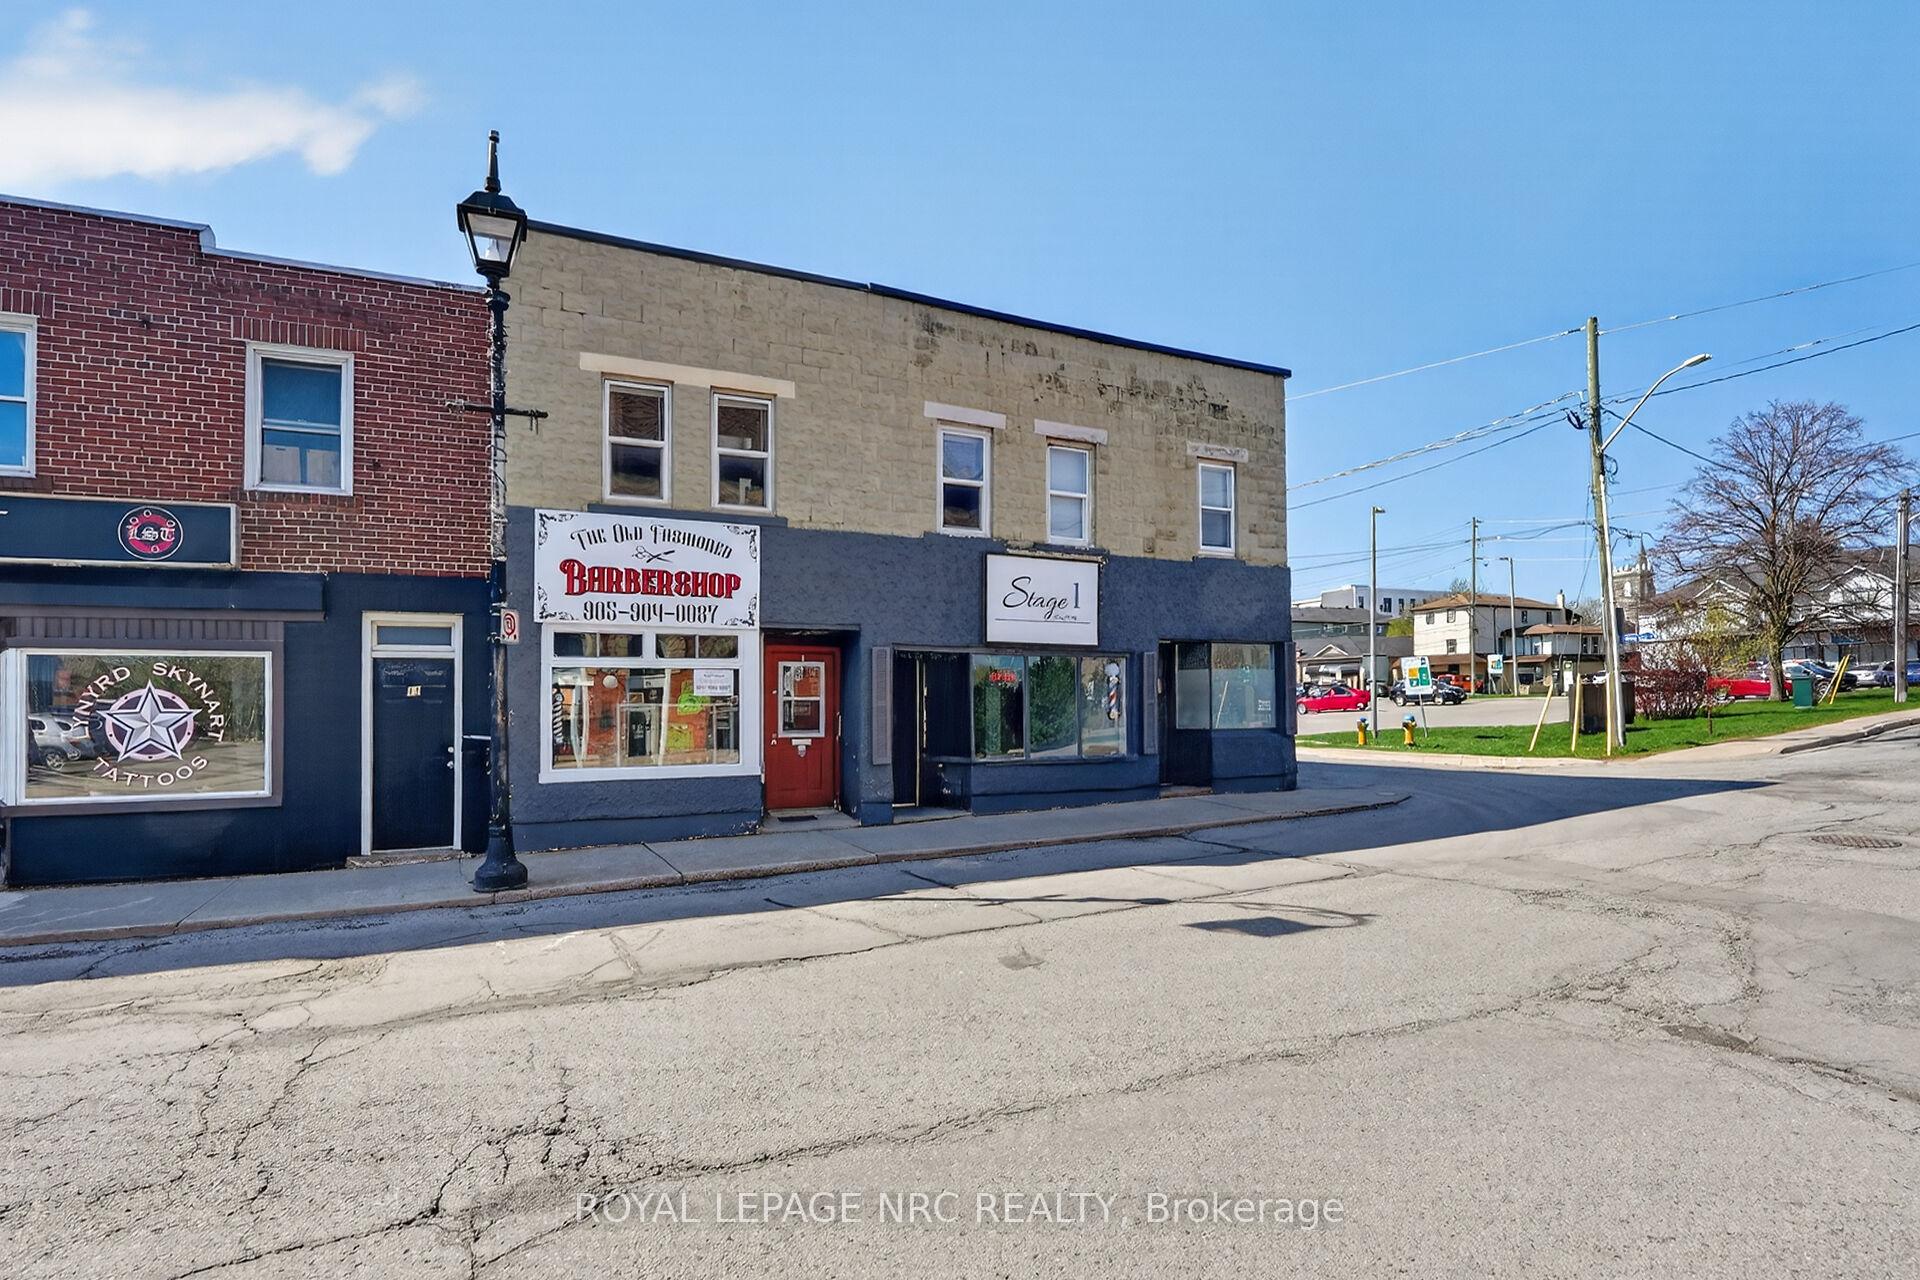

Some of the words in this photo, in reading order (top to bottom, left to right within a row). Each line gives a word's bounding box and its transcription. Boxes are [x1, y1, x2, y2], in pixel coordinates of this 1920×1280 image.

[612, 523, 643, 543] OLD
[559, 558, 741, 598] BARBERSHOP
[583, 600, 718, 624] 905-904-0087
[1002, 576, 1068, 619] Stage
[72, 666, 131, 740] LYNYRD
[152, 662, 225, 742] SKYNART
[93, 755, 208, 788] TATTOOS
